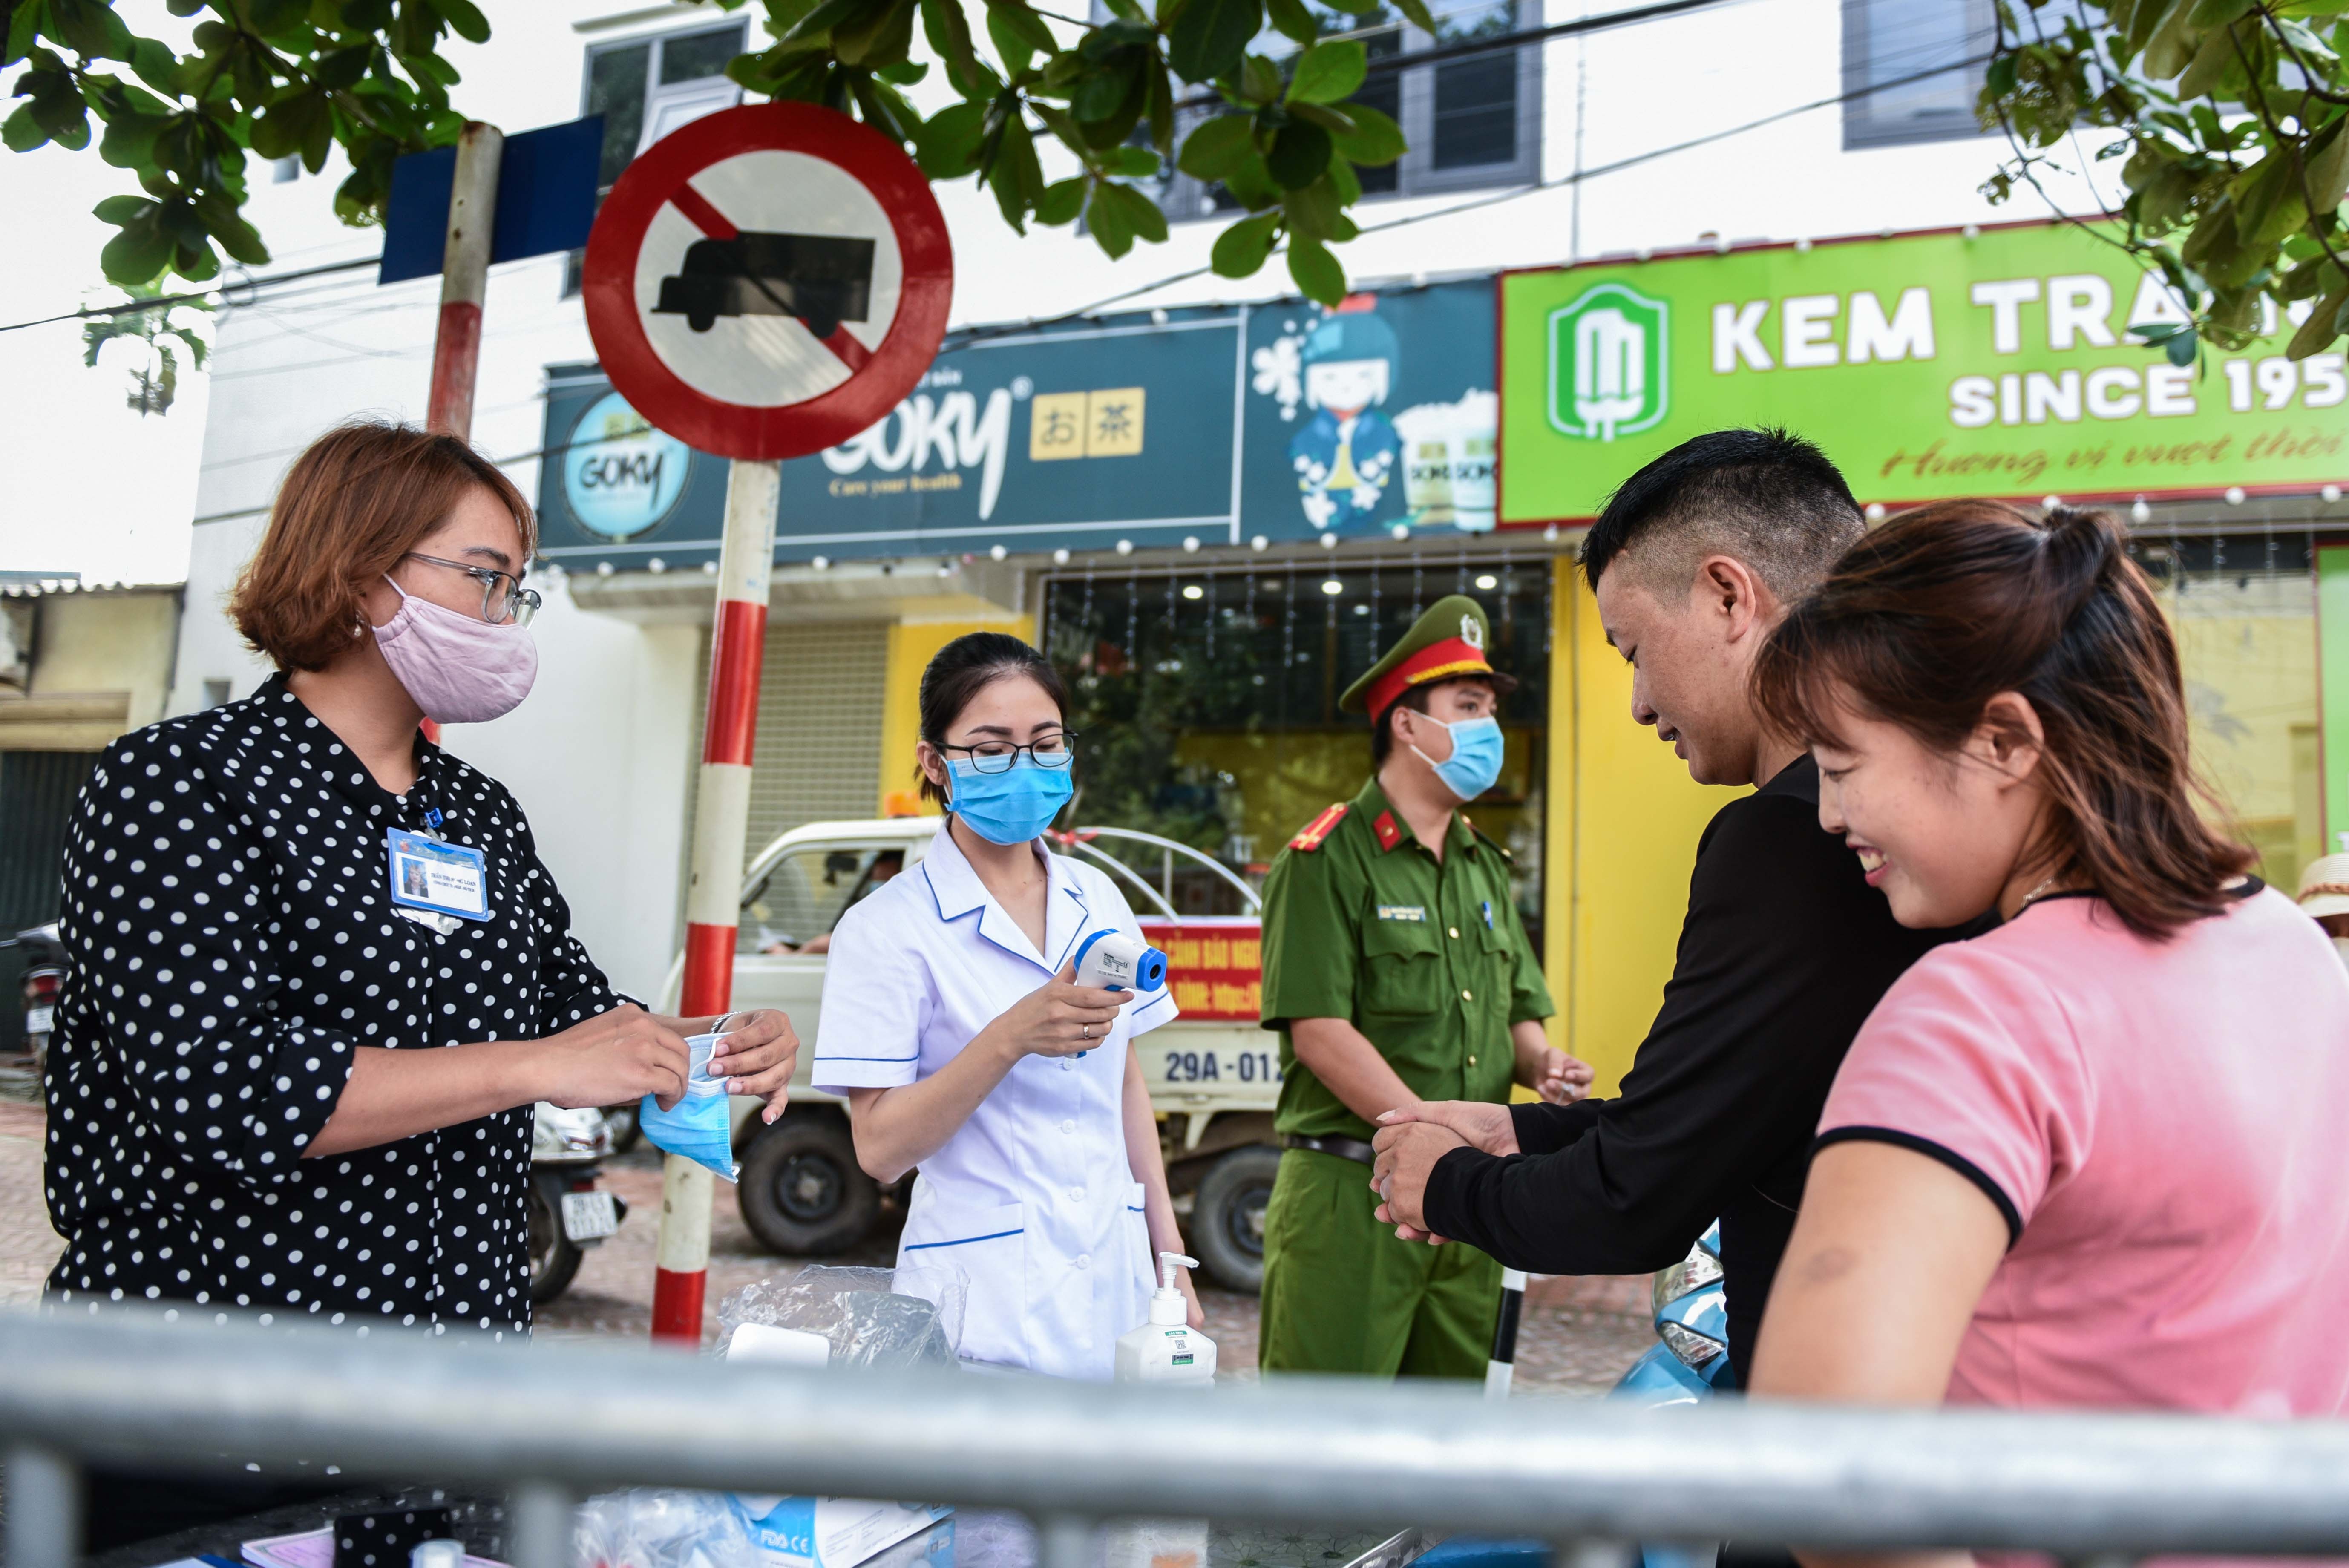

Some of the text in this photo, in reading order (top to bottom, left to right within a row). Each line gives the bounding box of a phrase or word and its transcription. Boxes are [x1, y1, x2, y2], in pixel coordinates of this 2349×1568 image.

[1713, 287, 1935, 373] KEM
[1950, 364, 2196, 427] SINCE
[761, 1529, 788, 1548] FDA
